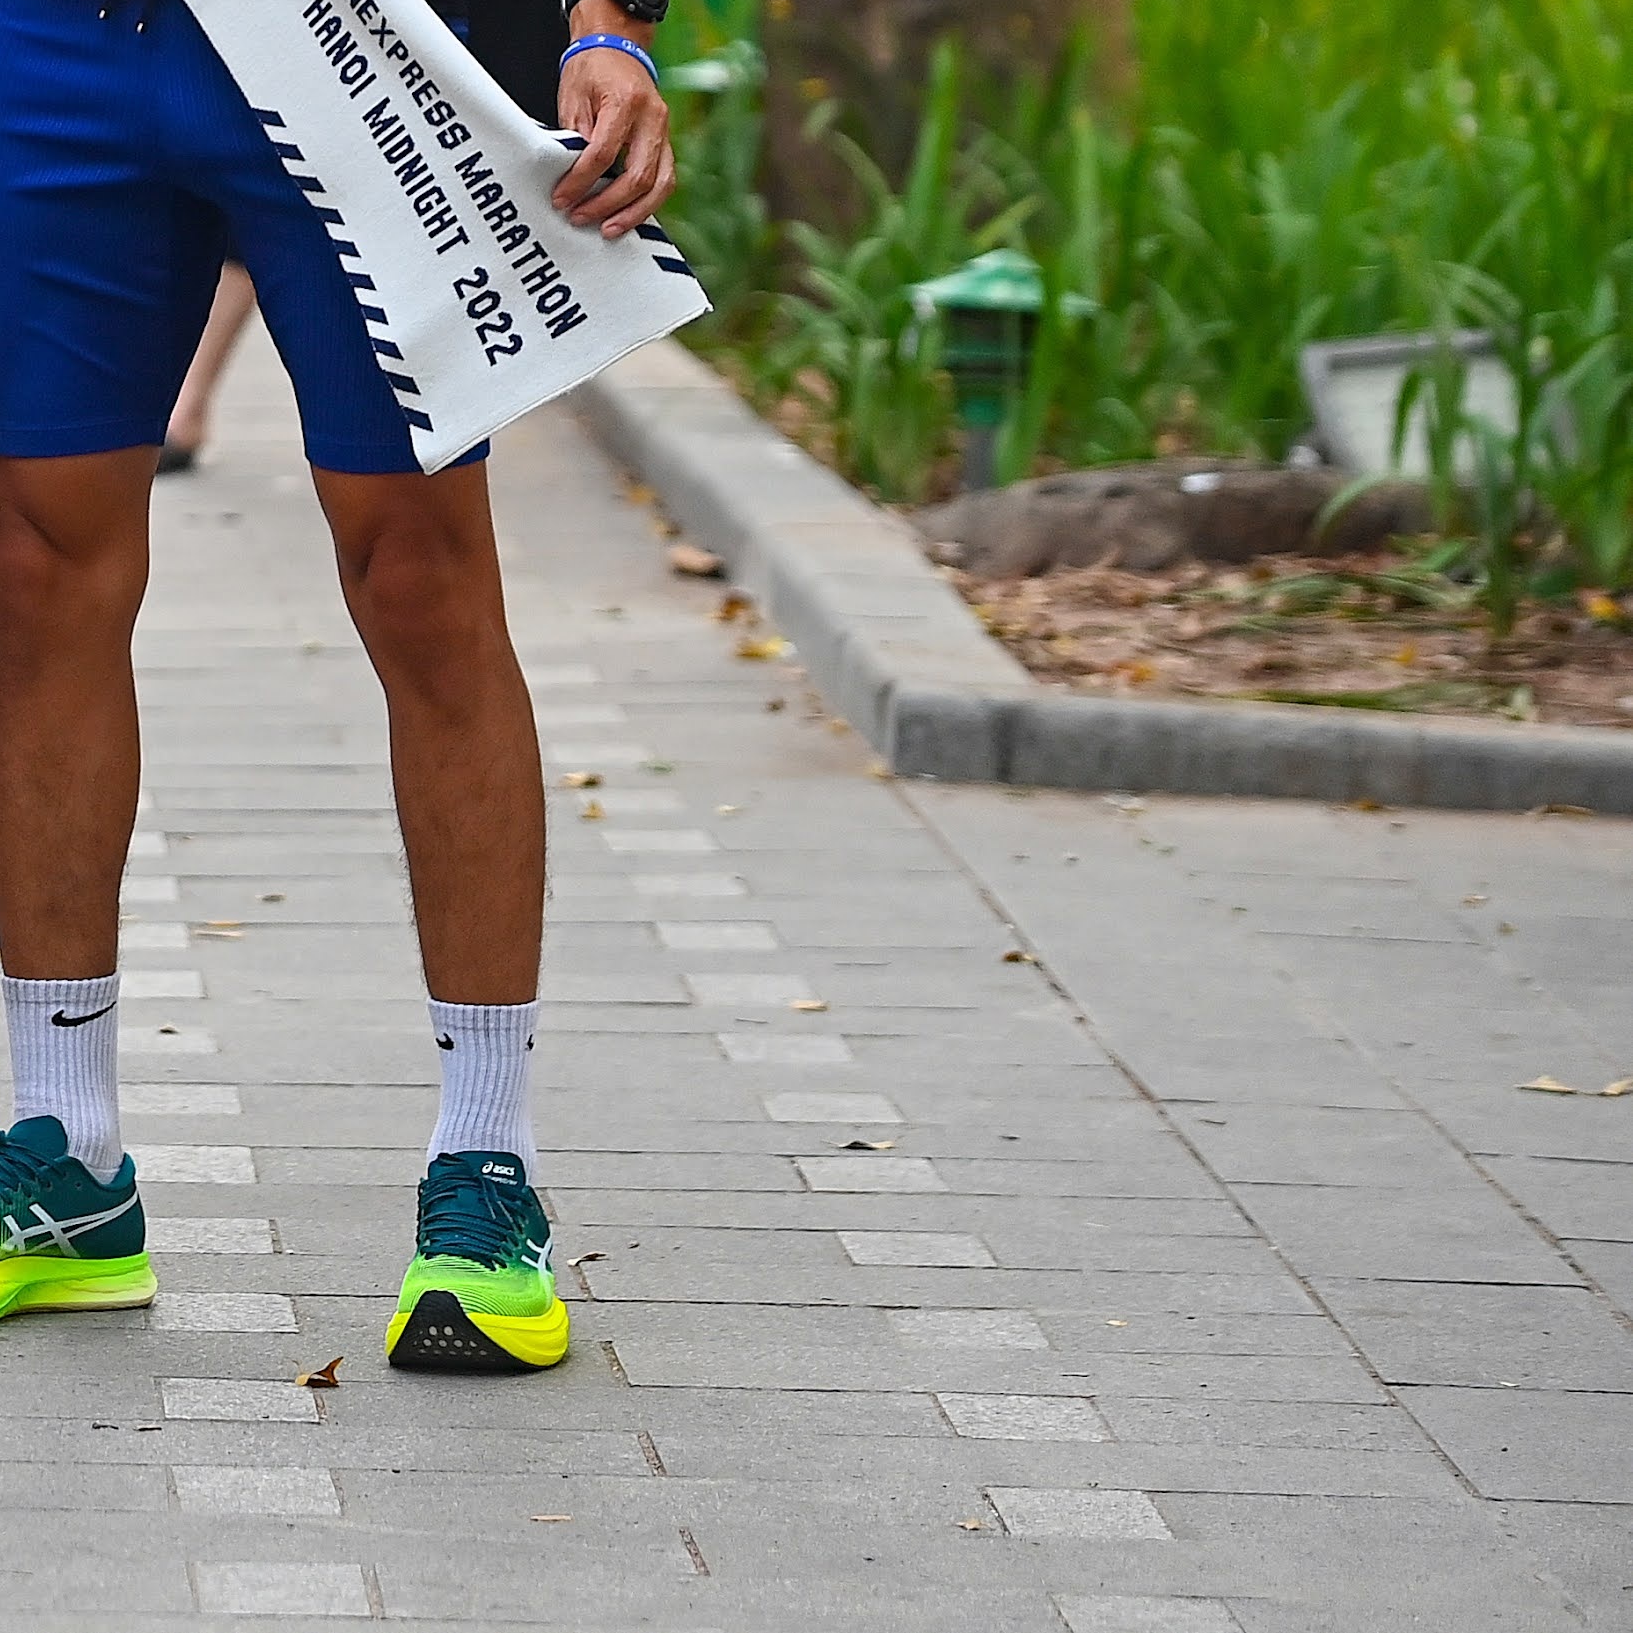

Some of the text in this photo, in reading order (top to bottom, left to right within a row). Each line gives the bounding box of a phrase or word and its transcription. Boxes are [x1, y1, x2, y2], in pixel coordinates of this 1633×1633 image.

[362, 97, 471, 256] MIDNIGHT
[452, 267, 525, 367] 2022
[454, 151, 588, 339] MARATHON
